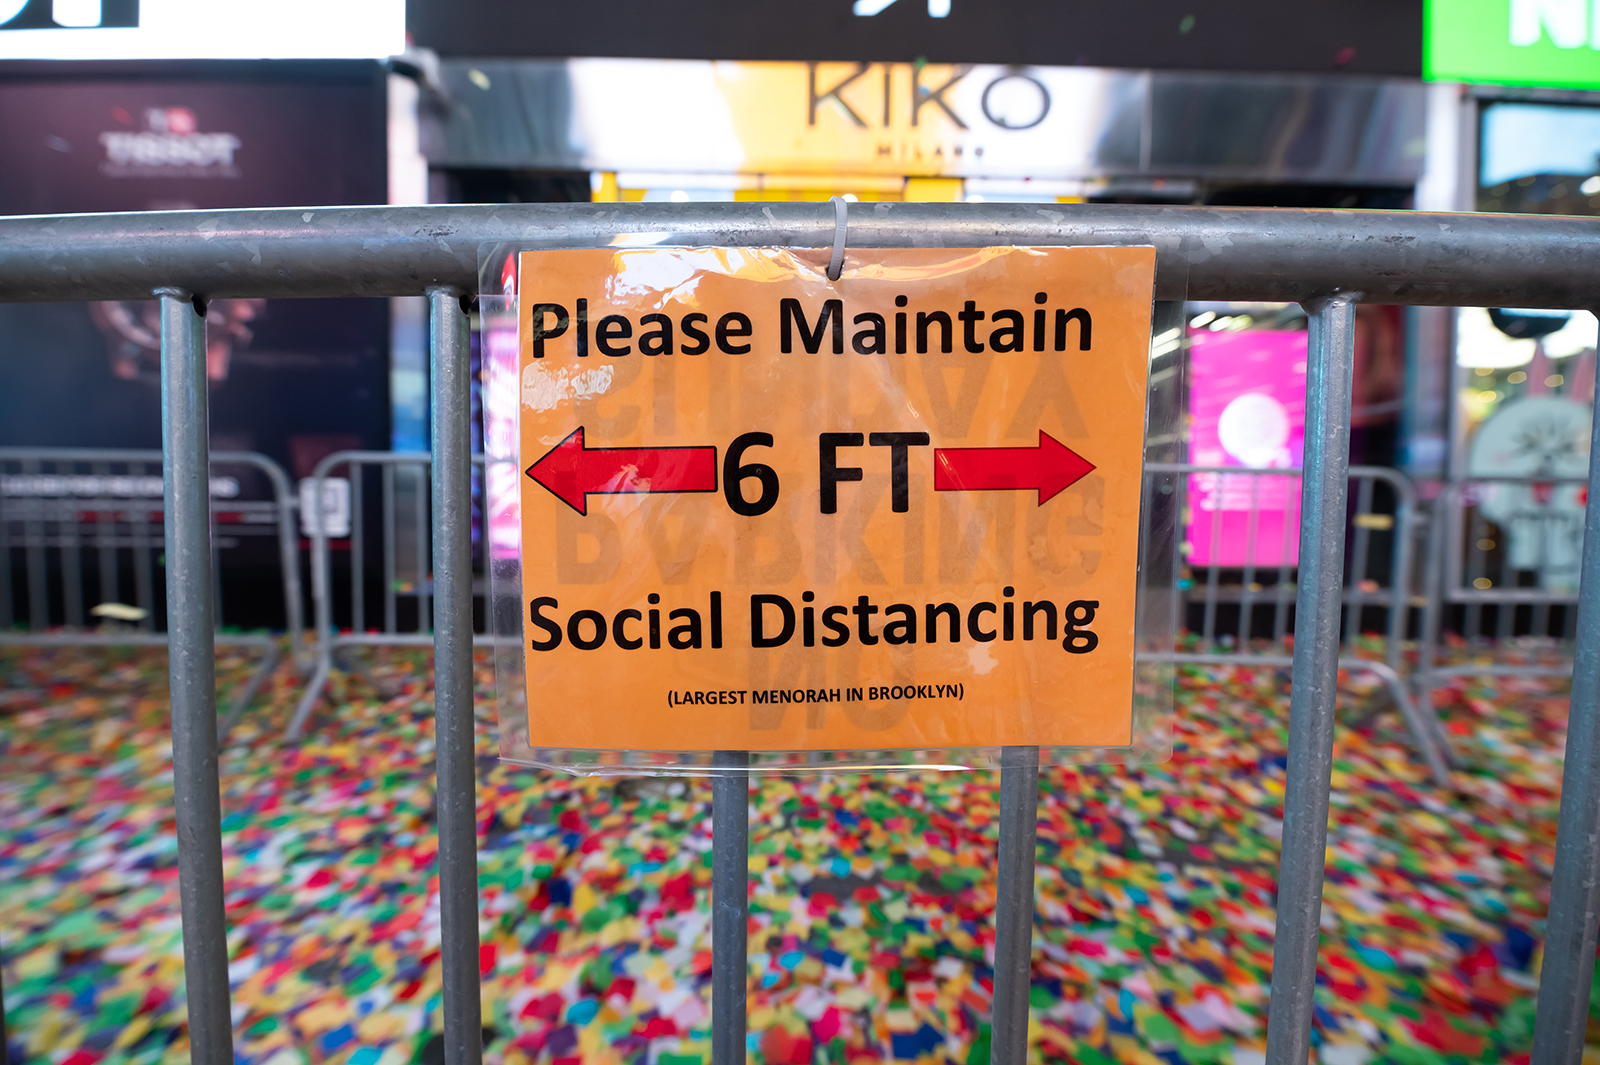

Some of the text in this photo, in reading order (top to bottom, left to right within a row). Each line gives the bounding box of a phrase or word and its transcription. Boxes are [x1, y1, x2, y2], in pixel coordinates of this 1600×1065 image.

[806, 66, 1051, 131] KIKO
[531, 291, 1093, 360] Please Maintain
[721, 431, 931, 517] 6 FT
[529, 585, 1101, 656] Social Distancing
[667, 682, 964, 709] (LARGEST MENORAH IN BROOKLYN)
